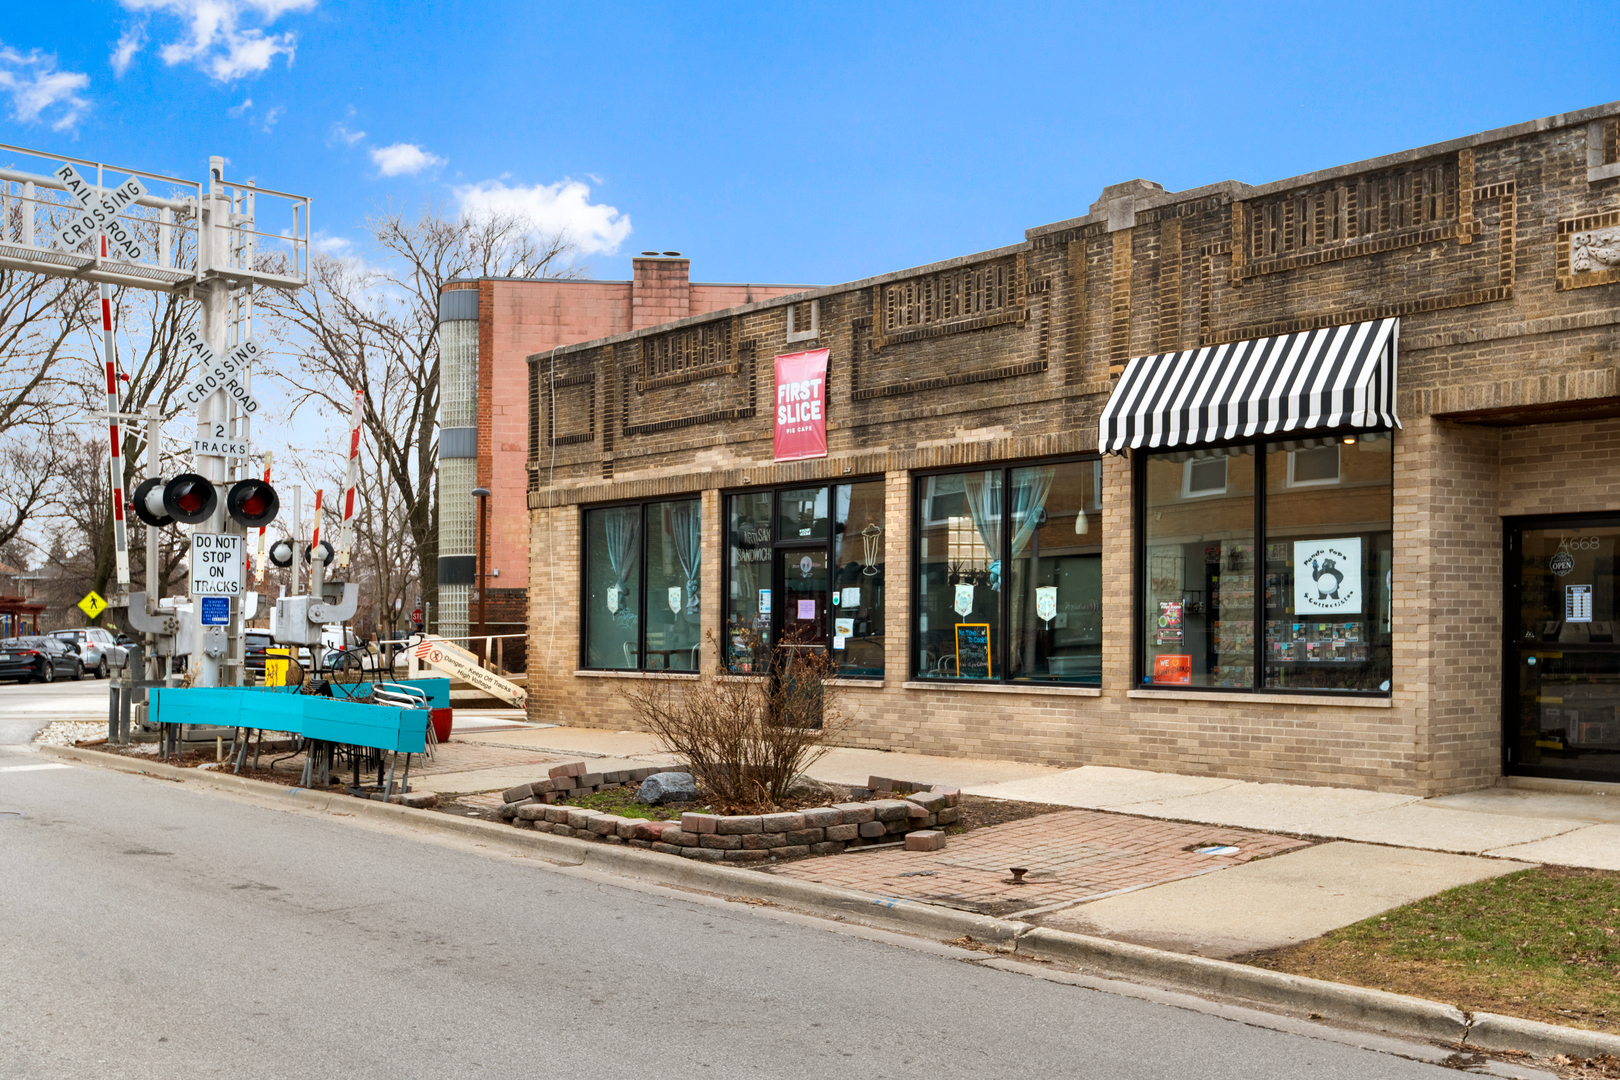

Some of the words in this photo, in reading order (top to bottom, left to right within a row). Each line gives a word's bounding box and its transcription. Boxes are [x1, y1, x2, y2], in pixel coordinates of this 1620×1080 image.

[58, 166, 92, 206] RAIL
[106, 220, 141, 260] ROAD
[62, 182, 140, 246] CROSSING
[183, 332, 214, 367] RAIL
[226, 380, 258, 415] ROAD
[187, 342, 258, 404] CROSSING
[778, 378, 822, 404] FIRST
[778, 400, 822, 425] SLICE
[216, 425, 224, 438] 2
[194, 440, 246, 454] TRACKS
[196, 536, 211, 548] DO
[216, 537, 238, 549] NOT
[1559, 537, 1600, 550] 4668
[202, 551, 232, 563] STOP
[1304, 550, 1324, 566] Panda
[1329, 548, 1347, 560] Pops
[209, 566, 224, 578] ON
[194, 580, 238, 593] TRACKS
[444, 655, 464, 668] Danger
[468, 668, 482, 679] Keep
[483, 674, 494, 683] Off
[493, 679, 511, 693] Tracks
[457, 669, 471, 680] High
[471, 676, 492, 690] Voltage
